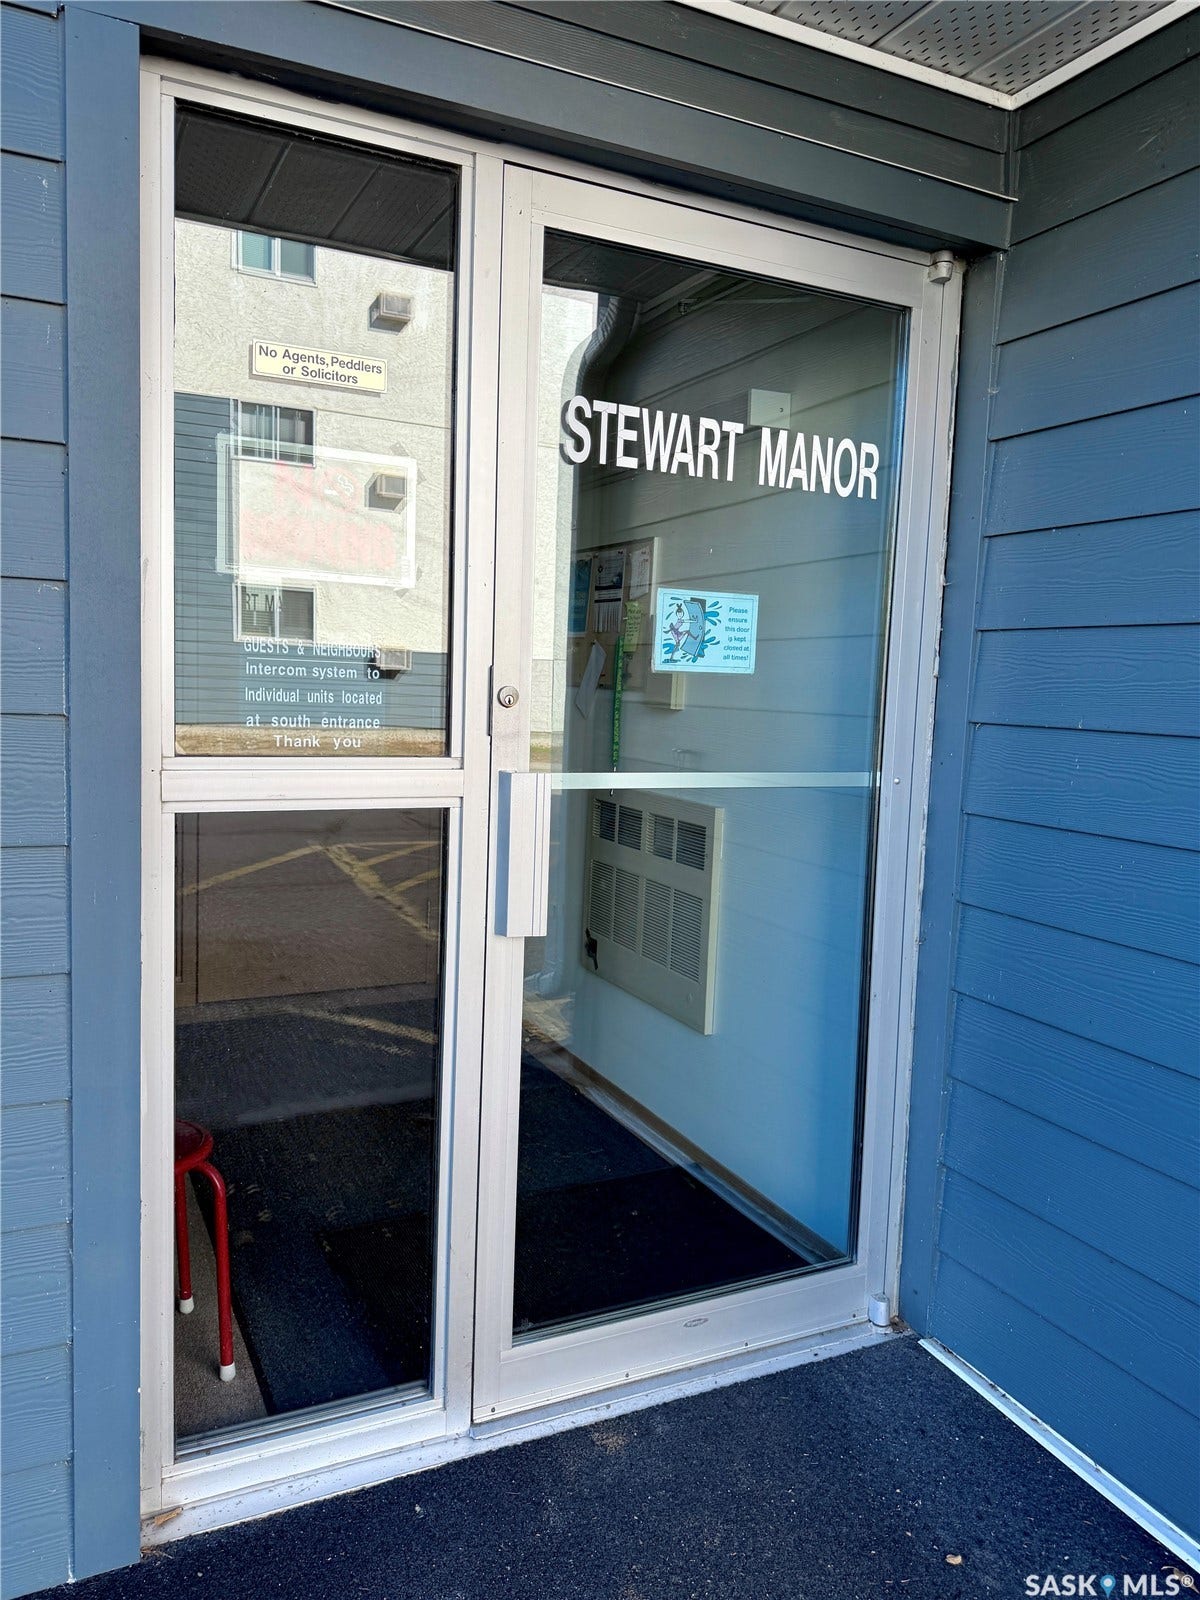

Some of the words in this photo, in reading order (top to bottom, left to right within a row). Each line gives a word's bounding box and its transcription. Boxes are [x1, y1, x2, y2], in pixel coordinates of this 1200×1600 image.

[258, 345, 278, 358] No
[282, 349, 329, 368] Agents,
[330, 356, 382, 374] Peddlers
[282, 365, 296, 375] or
[301, 366, 358, 385] Solicitors
[564, 395, 744, 482] STEWART
[758, 427, 880, 500] MANOR
[244, 637, 289, 654] GUESTS
[297, 639, 305, 655] &
[245, 661, 307, 677] Intercom
[312, 666, 358, 680] system
[367, 666, 380, 680] to
[245, 687, 300, 703] Individual
[307, 690, 334, 704] units
[342, 692, 383, 705] located
[246, 713, 261, 728] at
[271, 714, 311, 728] south
[321, 715, 380, 729] entrance
[273, 734, 321, 748] Thank
[333, 737, 362, 750] you
